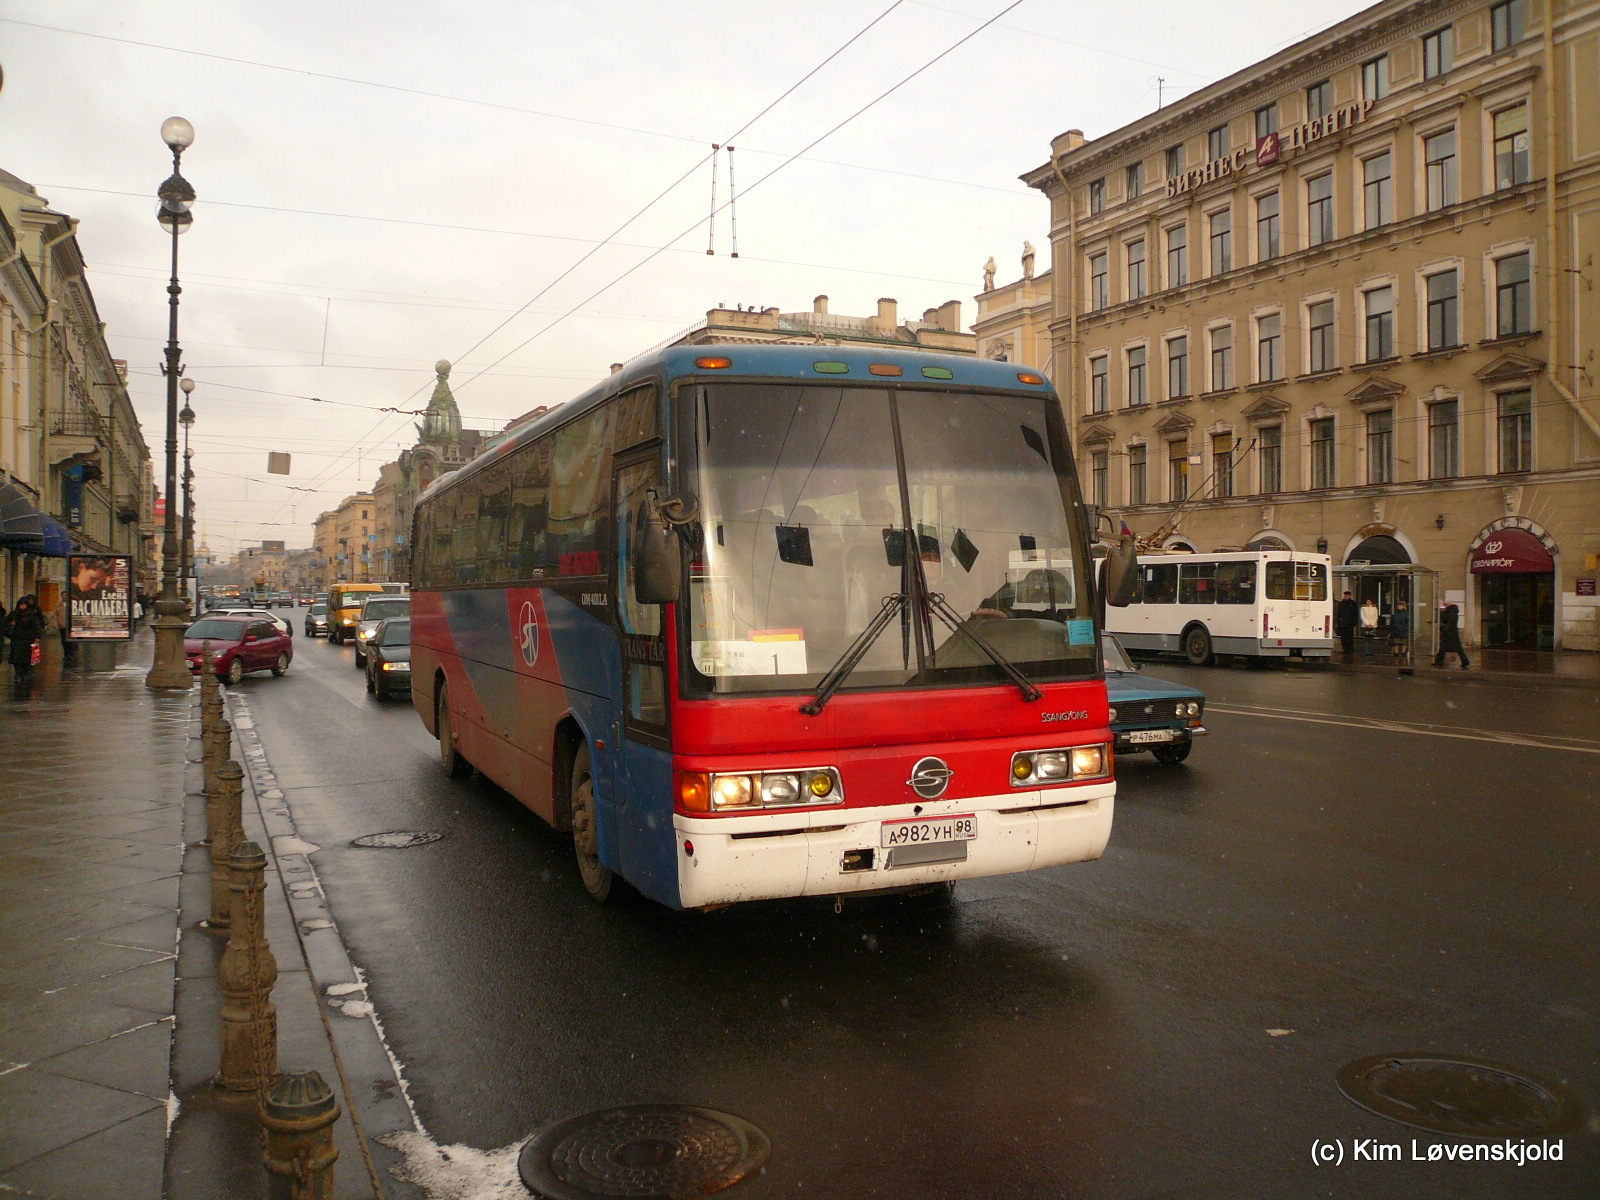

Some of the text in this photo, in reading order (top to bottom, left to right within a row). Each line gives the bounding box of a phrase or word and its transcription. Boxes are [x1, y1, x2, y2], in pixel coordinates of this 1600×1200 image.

[1165, 99, 1375, 199] БИЗНЕС ЦЕНТР
[101, 589, 128, 600] Елена
[71, 599, 129, 616] ВАСИЛЬЕВА
[955, 819, 972, 834] 98
